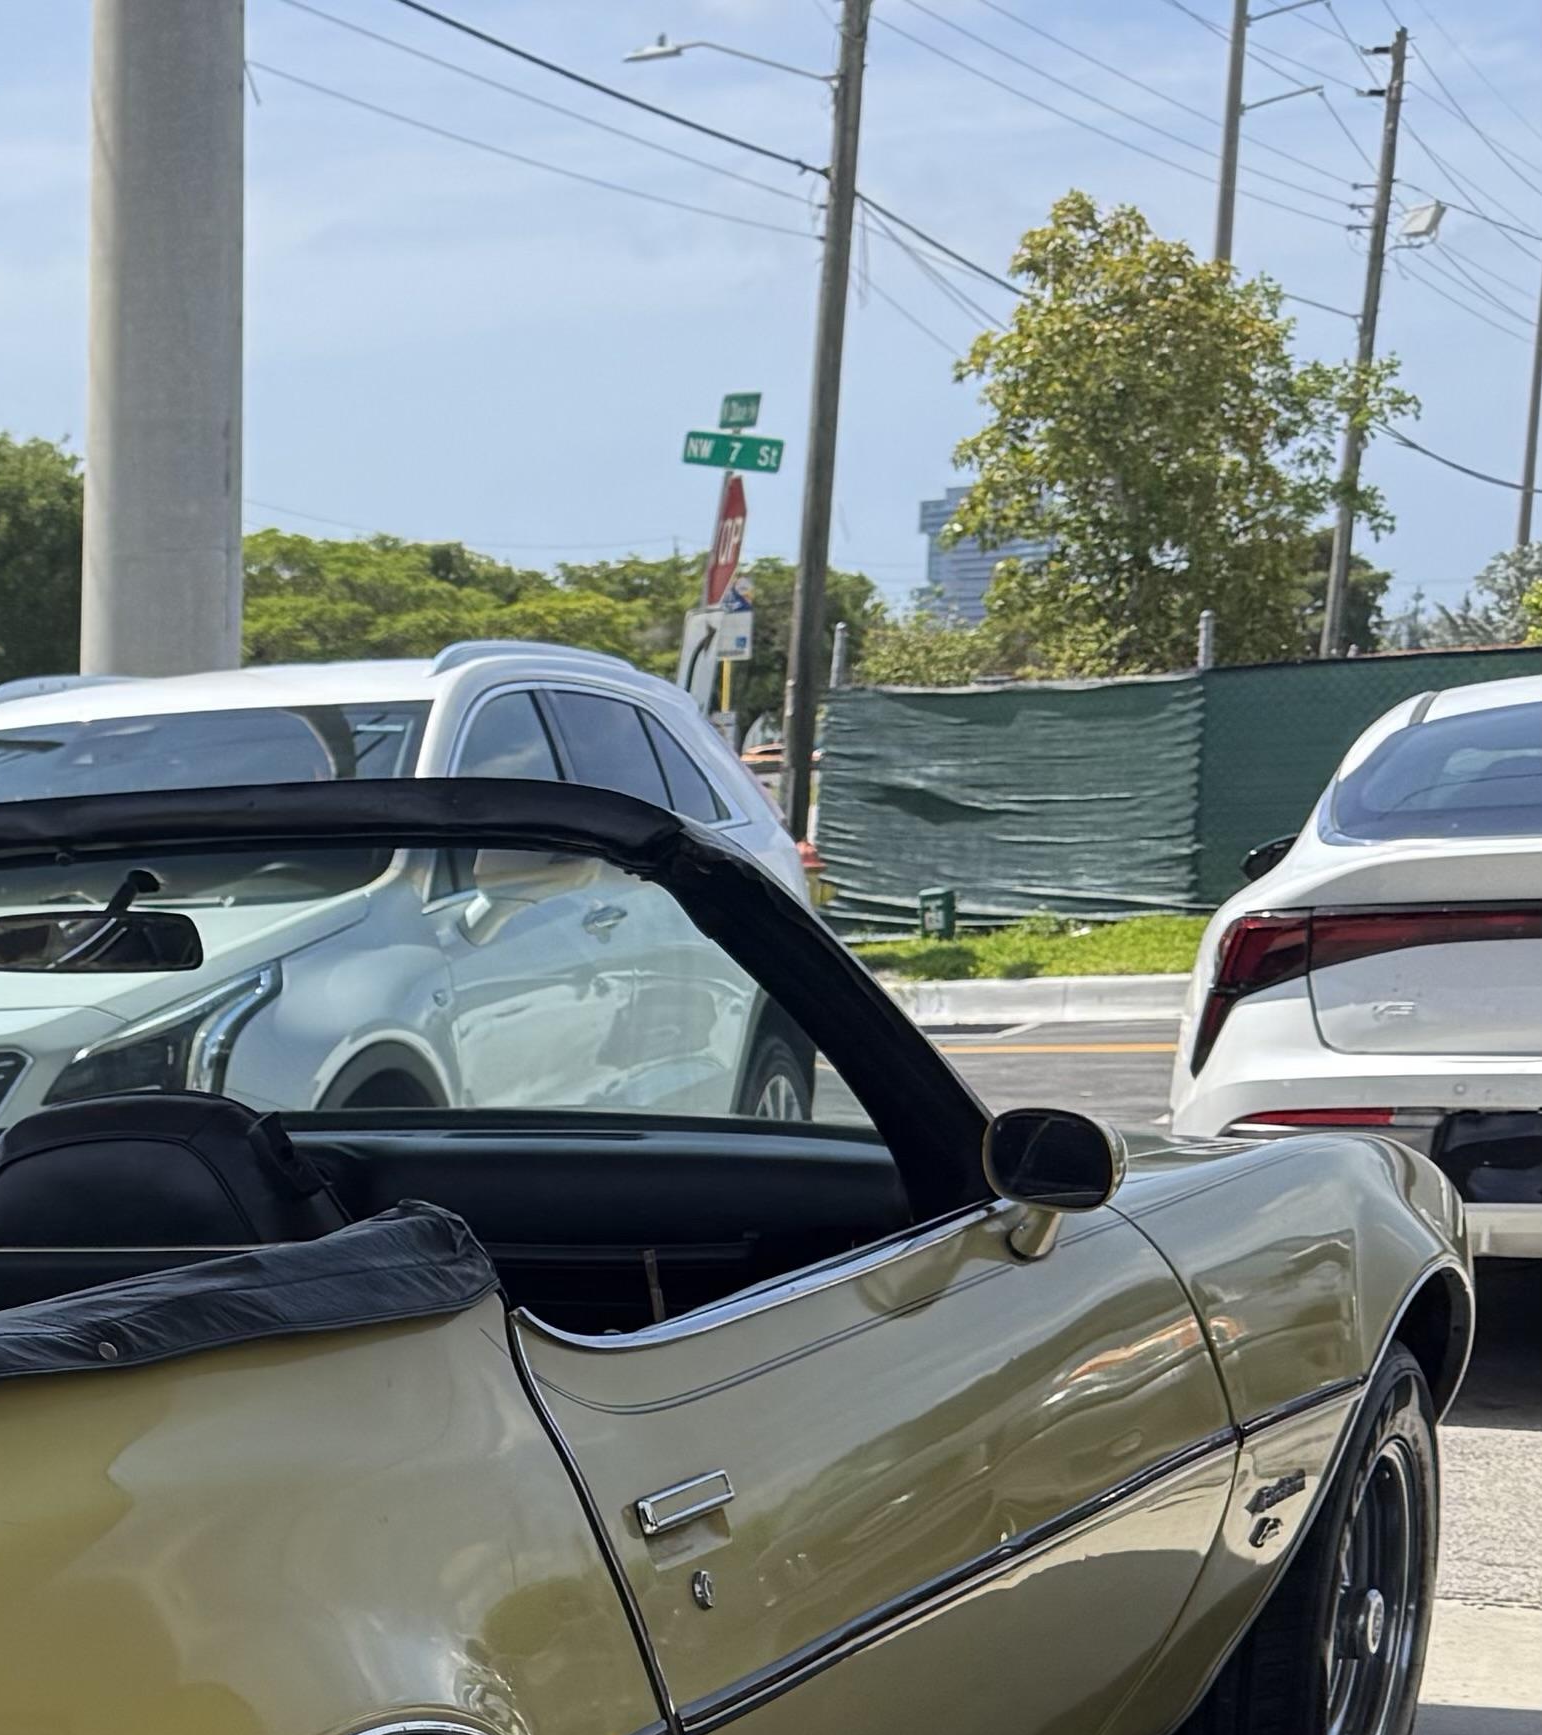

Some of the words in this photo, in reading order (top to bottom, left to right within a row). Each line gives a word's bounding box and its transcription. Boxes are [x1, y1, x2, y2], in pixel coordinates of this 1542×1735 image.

[687, 437, 715, 459] NW
[729, 442, 743, 463] 7
[757, 445, 778, 467] St
[718, 516, 743, 566] OP
